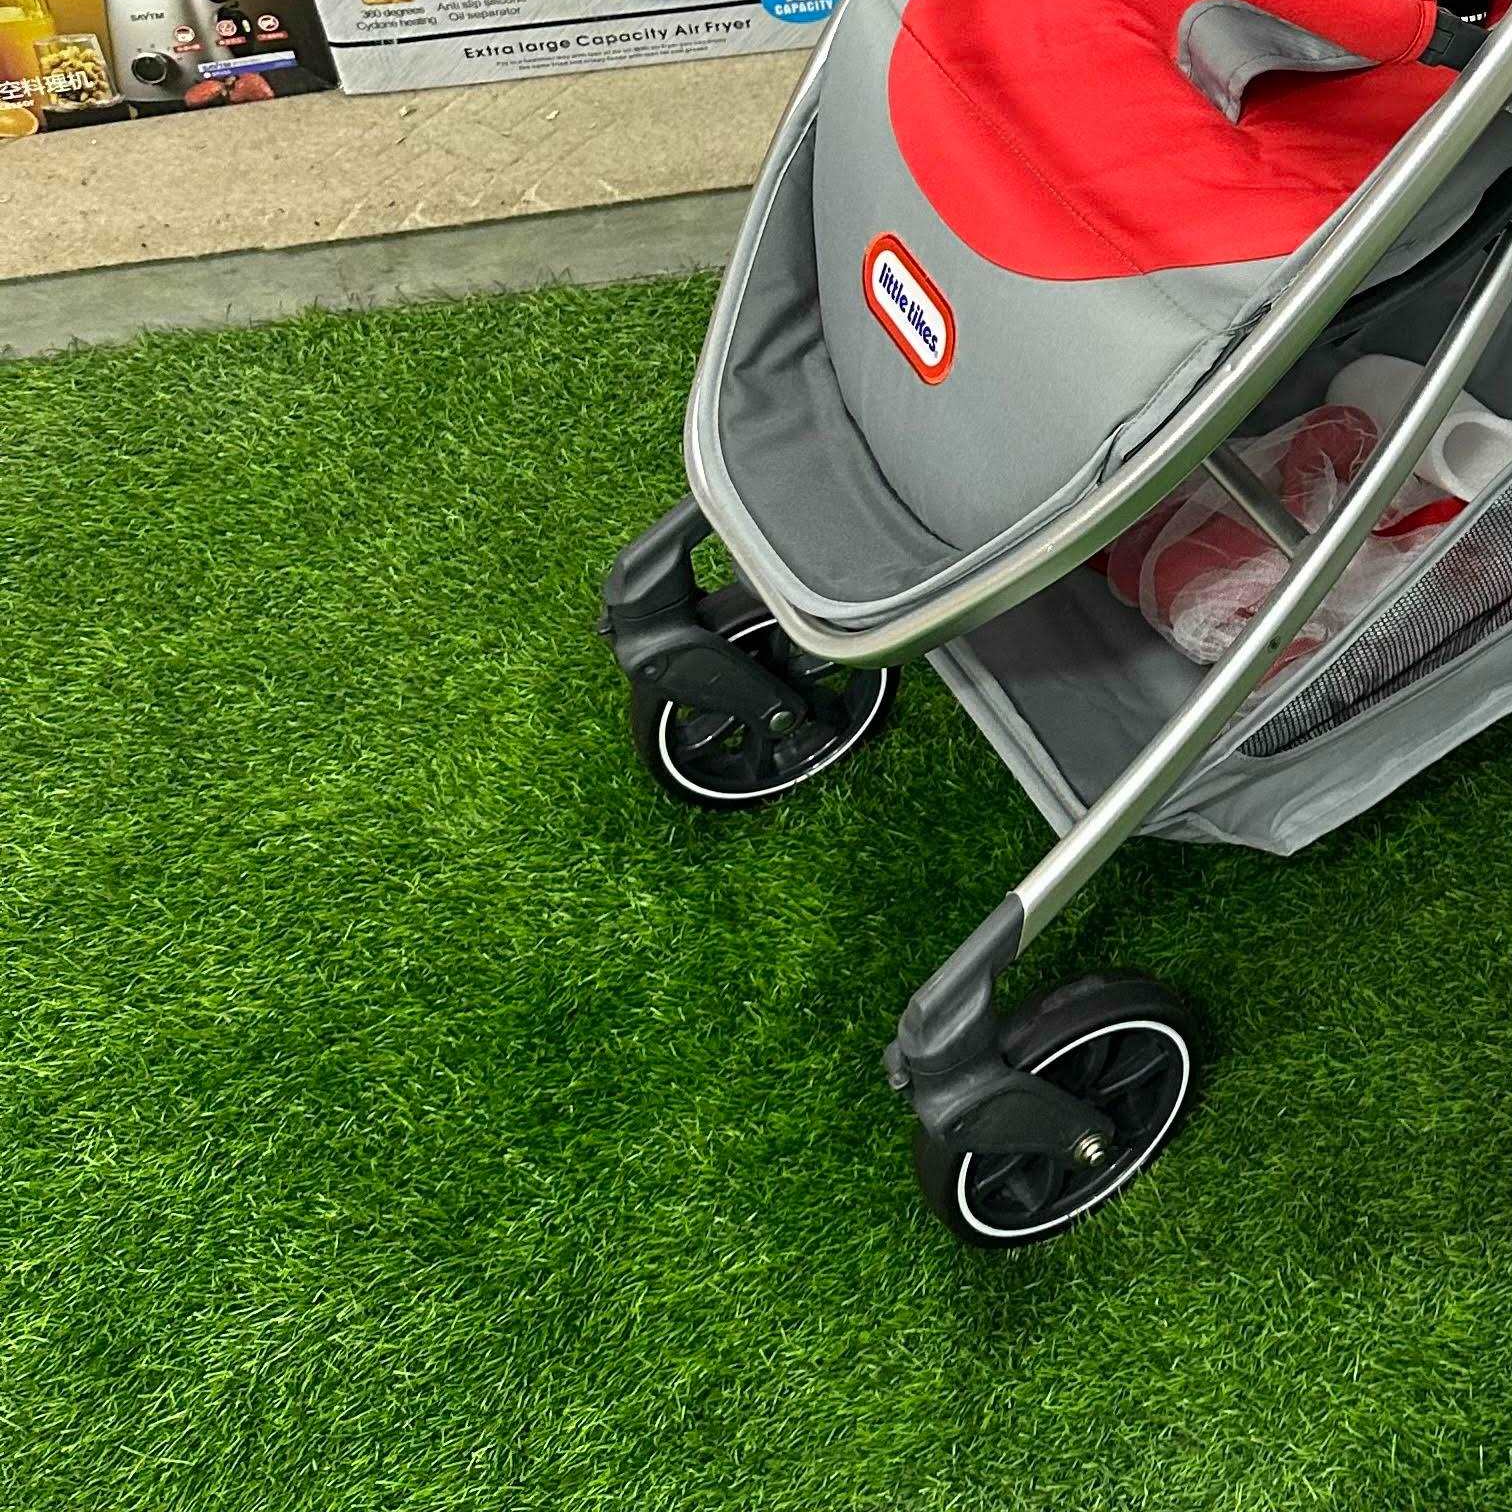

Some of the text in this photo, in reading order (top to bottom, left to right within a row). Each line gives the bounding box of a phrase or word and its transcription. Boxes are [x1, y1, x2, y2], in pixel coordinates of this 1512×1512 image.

[774, 0, 834, 16] CAPACITY
[464, 43, 514, 60] Extra
[518, 39, 571, 54] large
[576, 27, 669, 48] Capacity
[674, 22, 700, 37] Air
[704, 18, 753, 37] Fryer
[878, 262, 939, 353] little tikes
